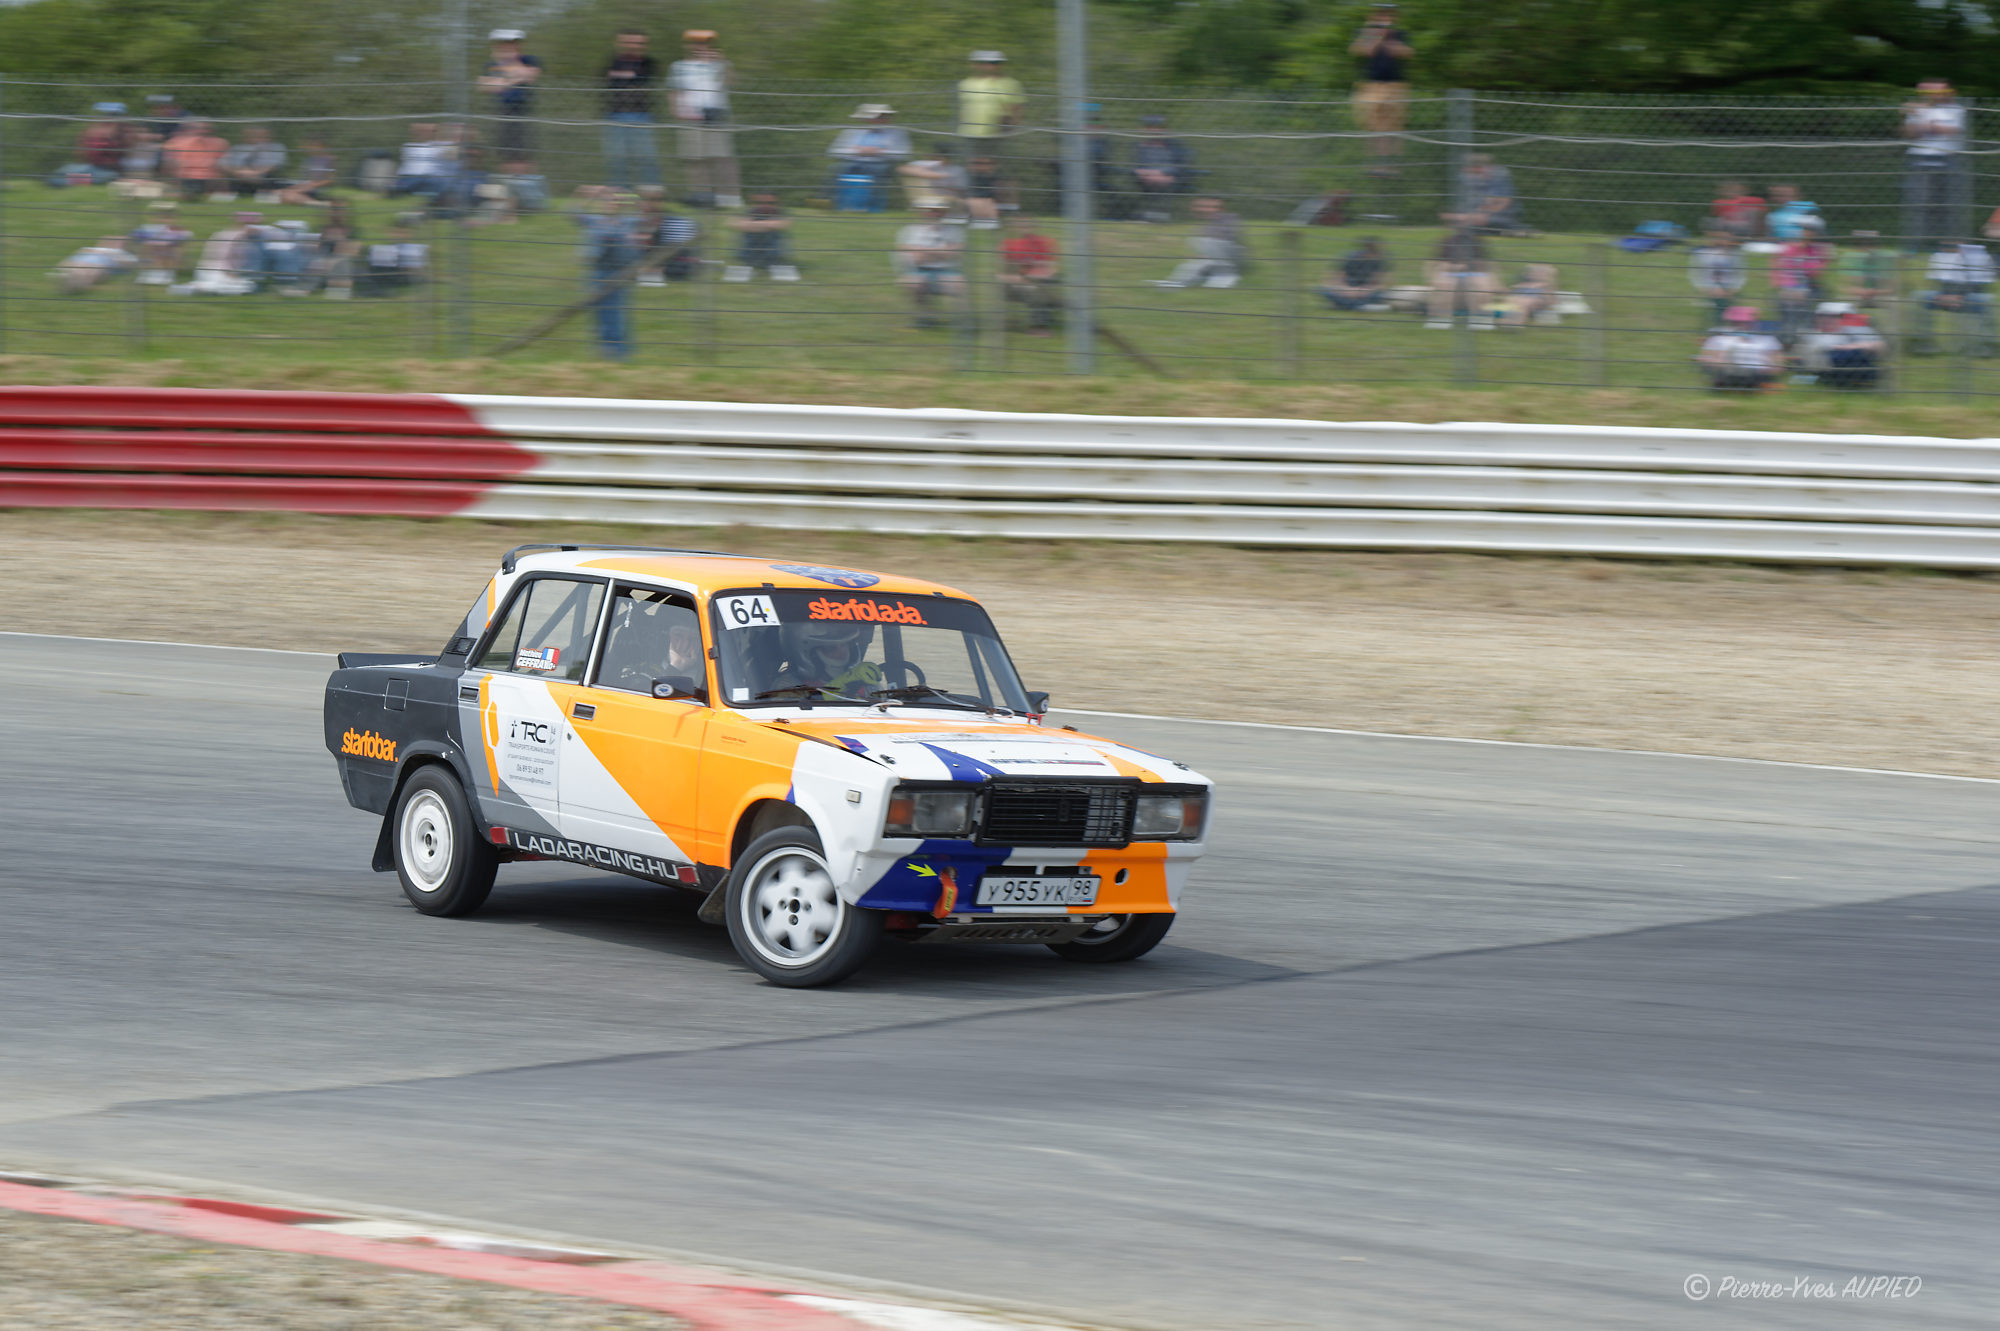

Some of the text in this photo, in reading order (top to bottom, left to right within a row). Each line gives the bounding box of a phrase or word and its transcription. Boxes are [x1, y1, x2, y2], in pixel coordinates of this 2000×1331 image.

[730, 597, 768, 625] 64
[514, 832, 680, 880] LADARACING.HU
[1003, 880, 1041, 901] 955
[1073, 879, 1092, 896] 98
